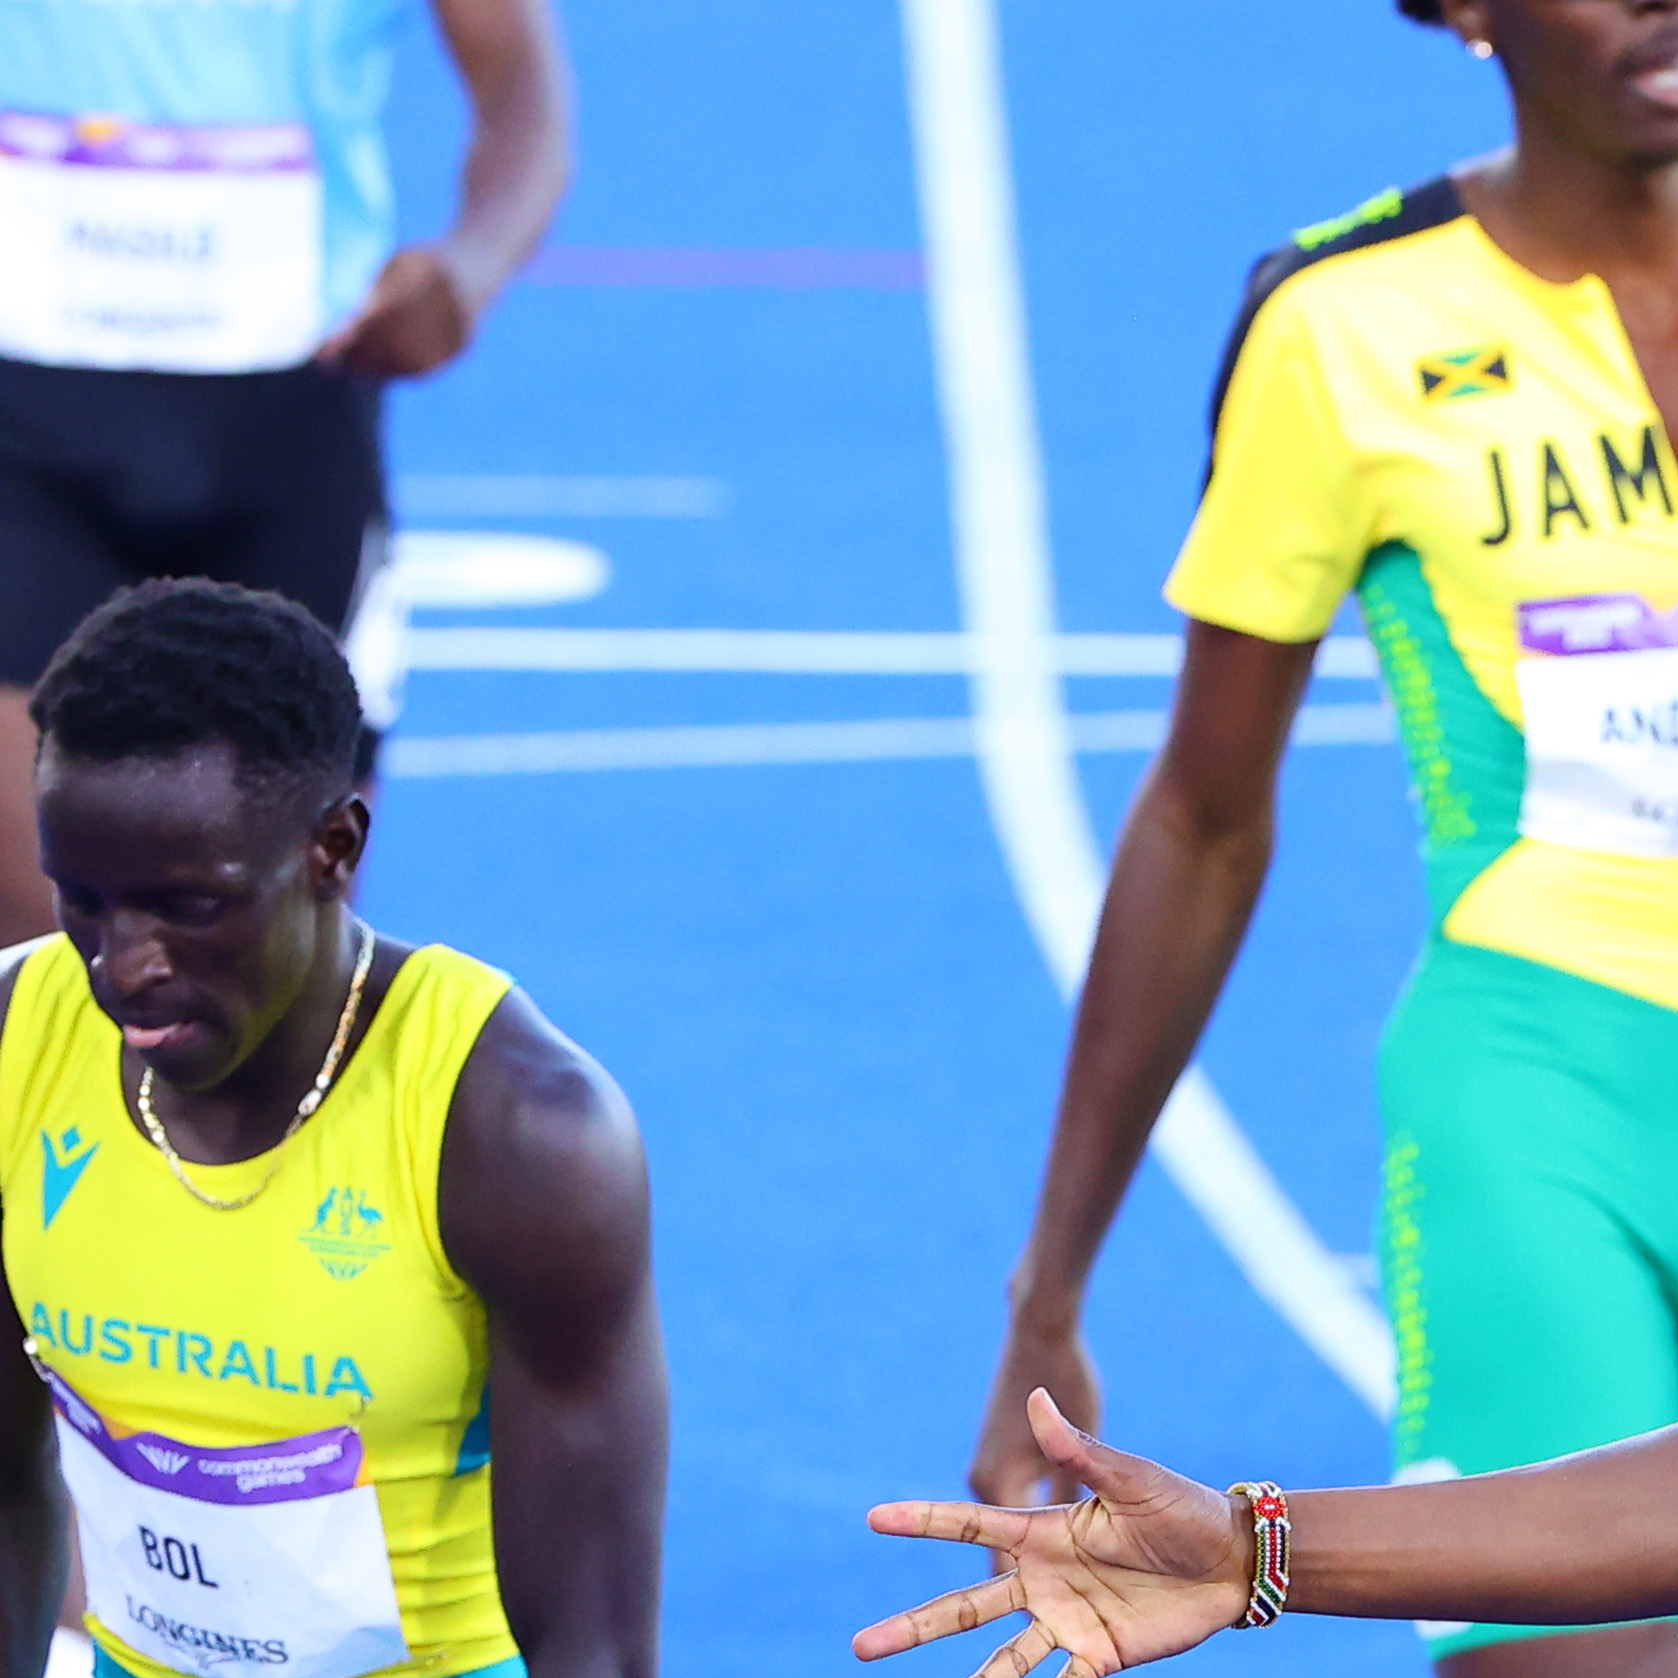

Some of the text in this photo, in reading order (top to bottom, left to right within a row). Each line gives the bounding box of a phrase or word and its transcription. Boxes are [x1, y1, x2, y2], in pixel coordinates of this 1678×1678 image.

[32, 1301, 374, 1400] AUSTRALIA
[138, 1525, 220, 1589] BOL
[125, 1594, 289, 1664] LONGINES
